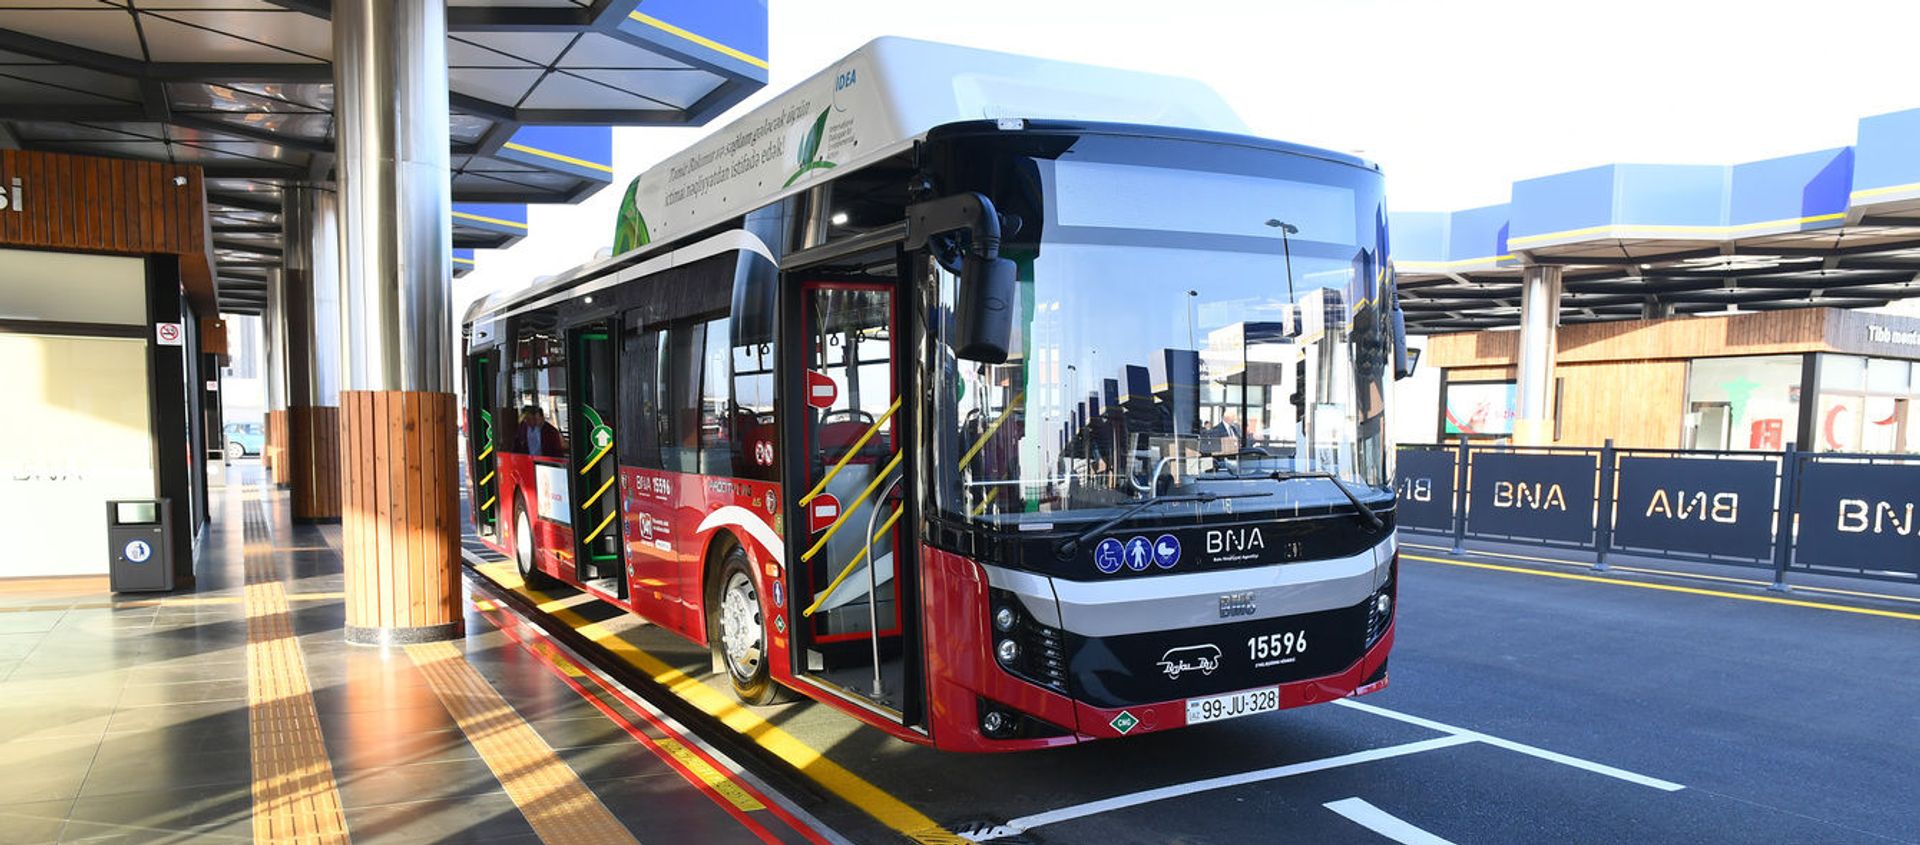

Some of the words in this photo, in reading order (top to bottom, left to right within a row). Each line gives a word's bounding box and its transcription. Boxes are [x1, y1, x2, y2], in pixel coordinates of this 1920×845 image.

[835, 69, 857, 92] IDEA
[1867, 325, 1891, 343] Tibb
[1493, 480, 1567, 512] BNA
[1837, 498, 1920, 536] BN
[1206, 527, 1265, 554] BNA
[1219, 591, 1257, 618] BMC
[1247, 630, 1307, 661] 15596
